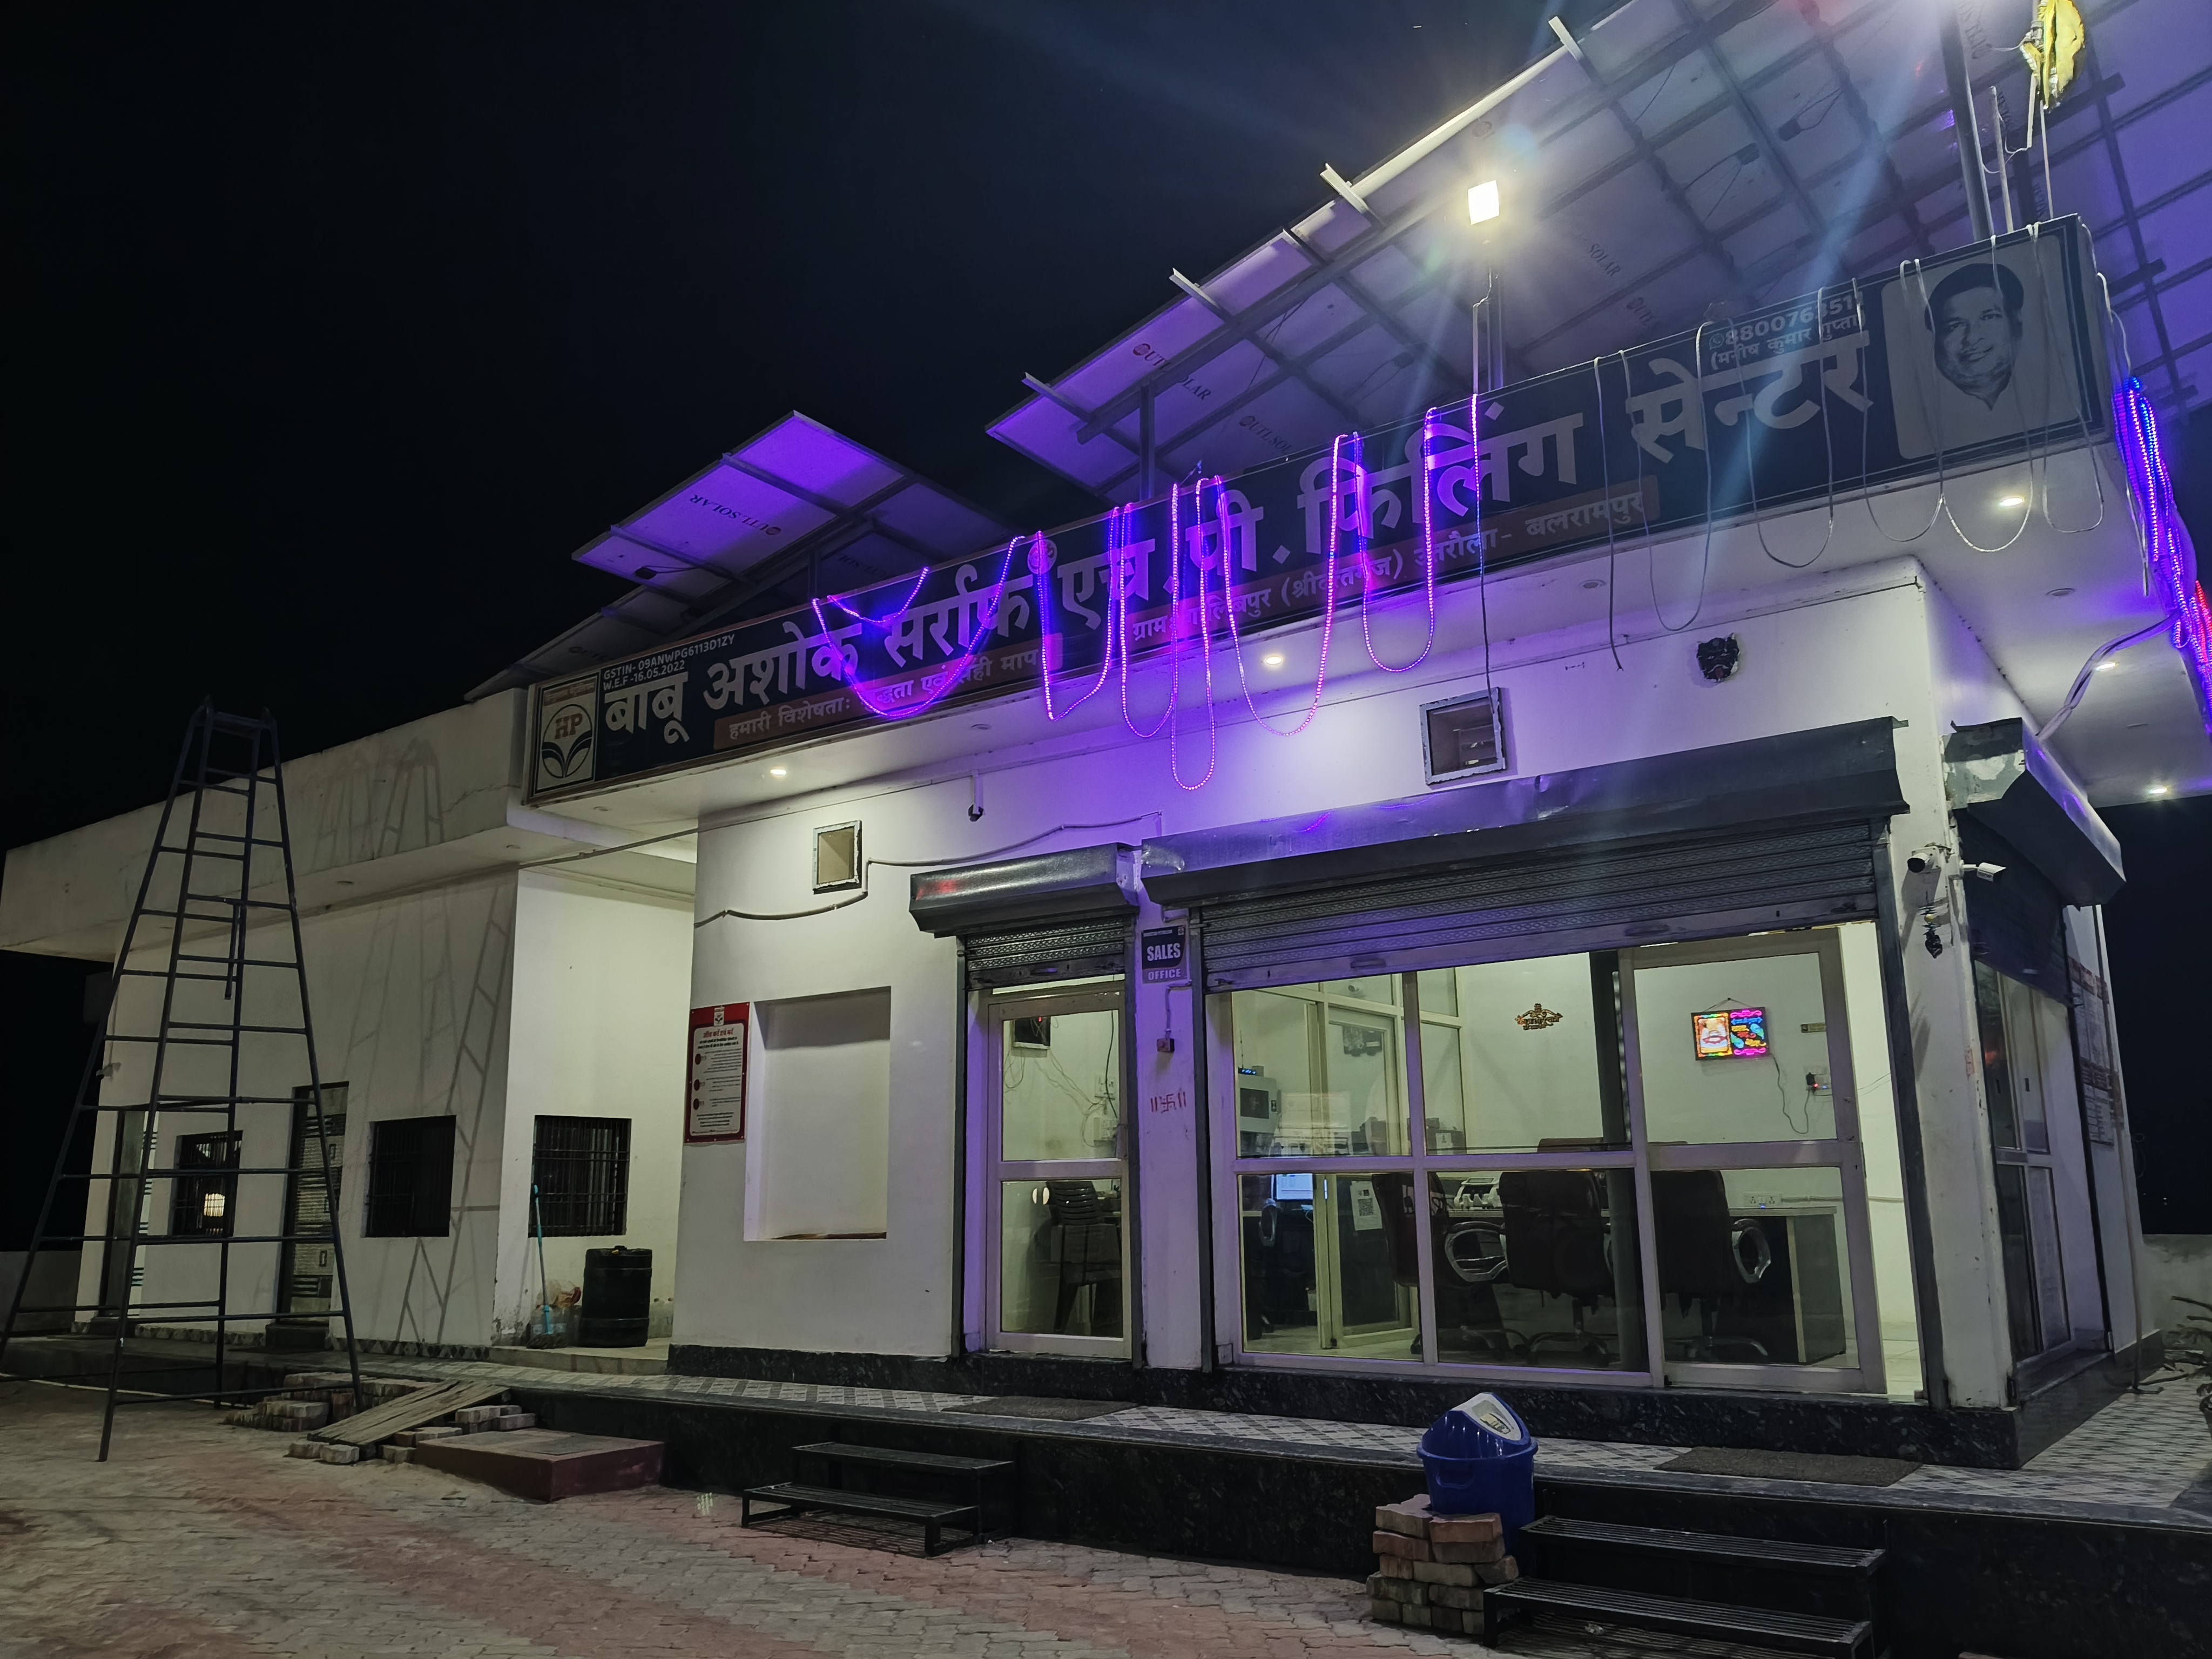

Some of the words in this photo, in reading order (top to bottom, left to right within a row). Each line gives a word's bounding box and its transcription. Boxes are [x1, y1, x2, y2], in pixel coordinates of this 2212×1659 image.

[1766, 328, 1812, 354] कुमार
[689, 494, 742, 519] SOLAR
[1525, 490, 1644, 537] बलरामपुर
[604, 671, 690, 744] बाबू
[703, 621, 862, 710] अशोक
[1297, 401, 1583, 555] फिलिंग
[1625, 329, 1874, 463] सेन्टर
[638, 634, 735, 671] 09ANWPG6113D1ZY
[729, 709, 771, 740] हमारी
[920, 664, 948, 694] एवं
[1000, 649, 1038, 671] माप
[554, 712, 583, 740] HP
[1147, 942, 1181, 962] SALES
[1148, 968, 1181, 981] OFFICE
